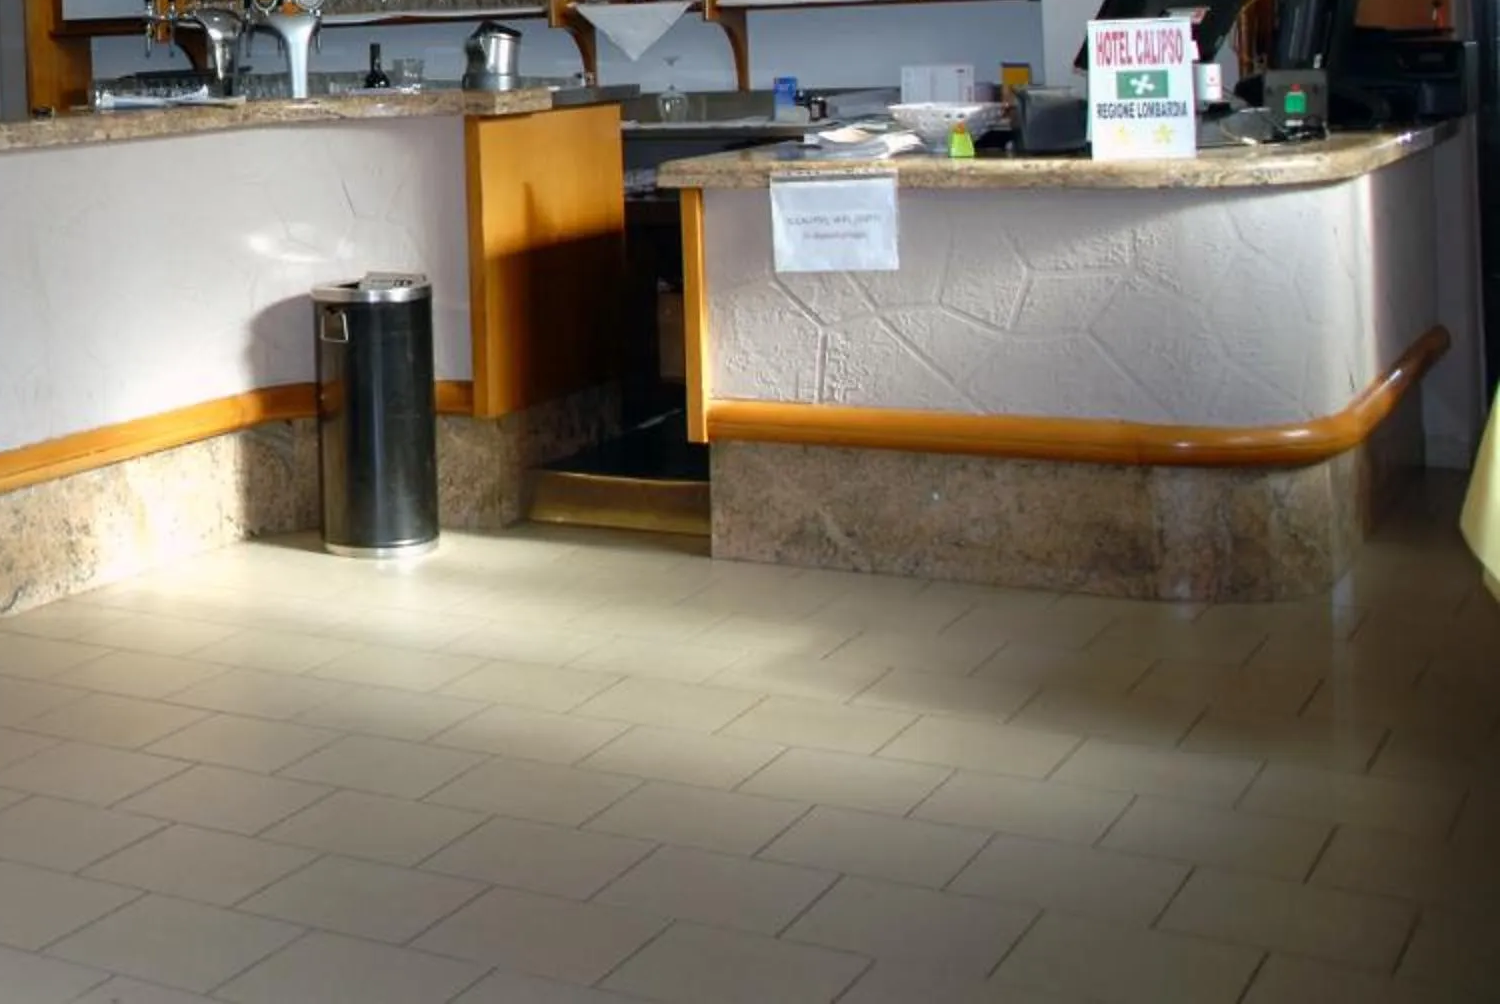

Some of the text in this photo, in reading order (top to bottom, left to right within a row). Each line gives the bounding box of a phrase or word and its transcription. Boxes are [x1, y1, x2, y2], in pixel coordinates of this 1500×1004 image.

[1095, 28, 1184, 67] HOTEL CALIPSO
[1096, 100, 1188, 119] REGIONE LOMBARDIA
